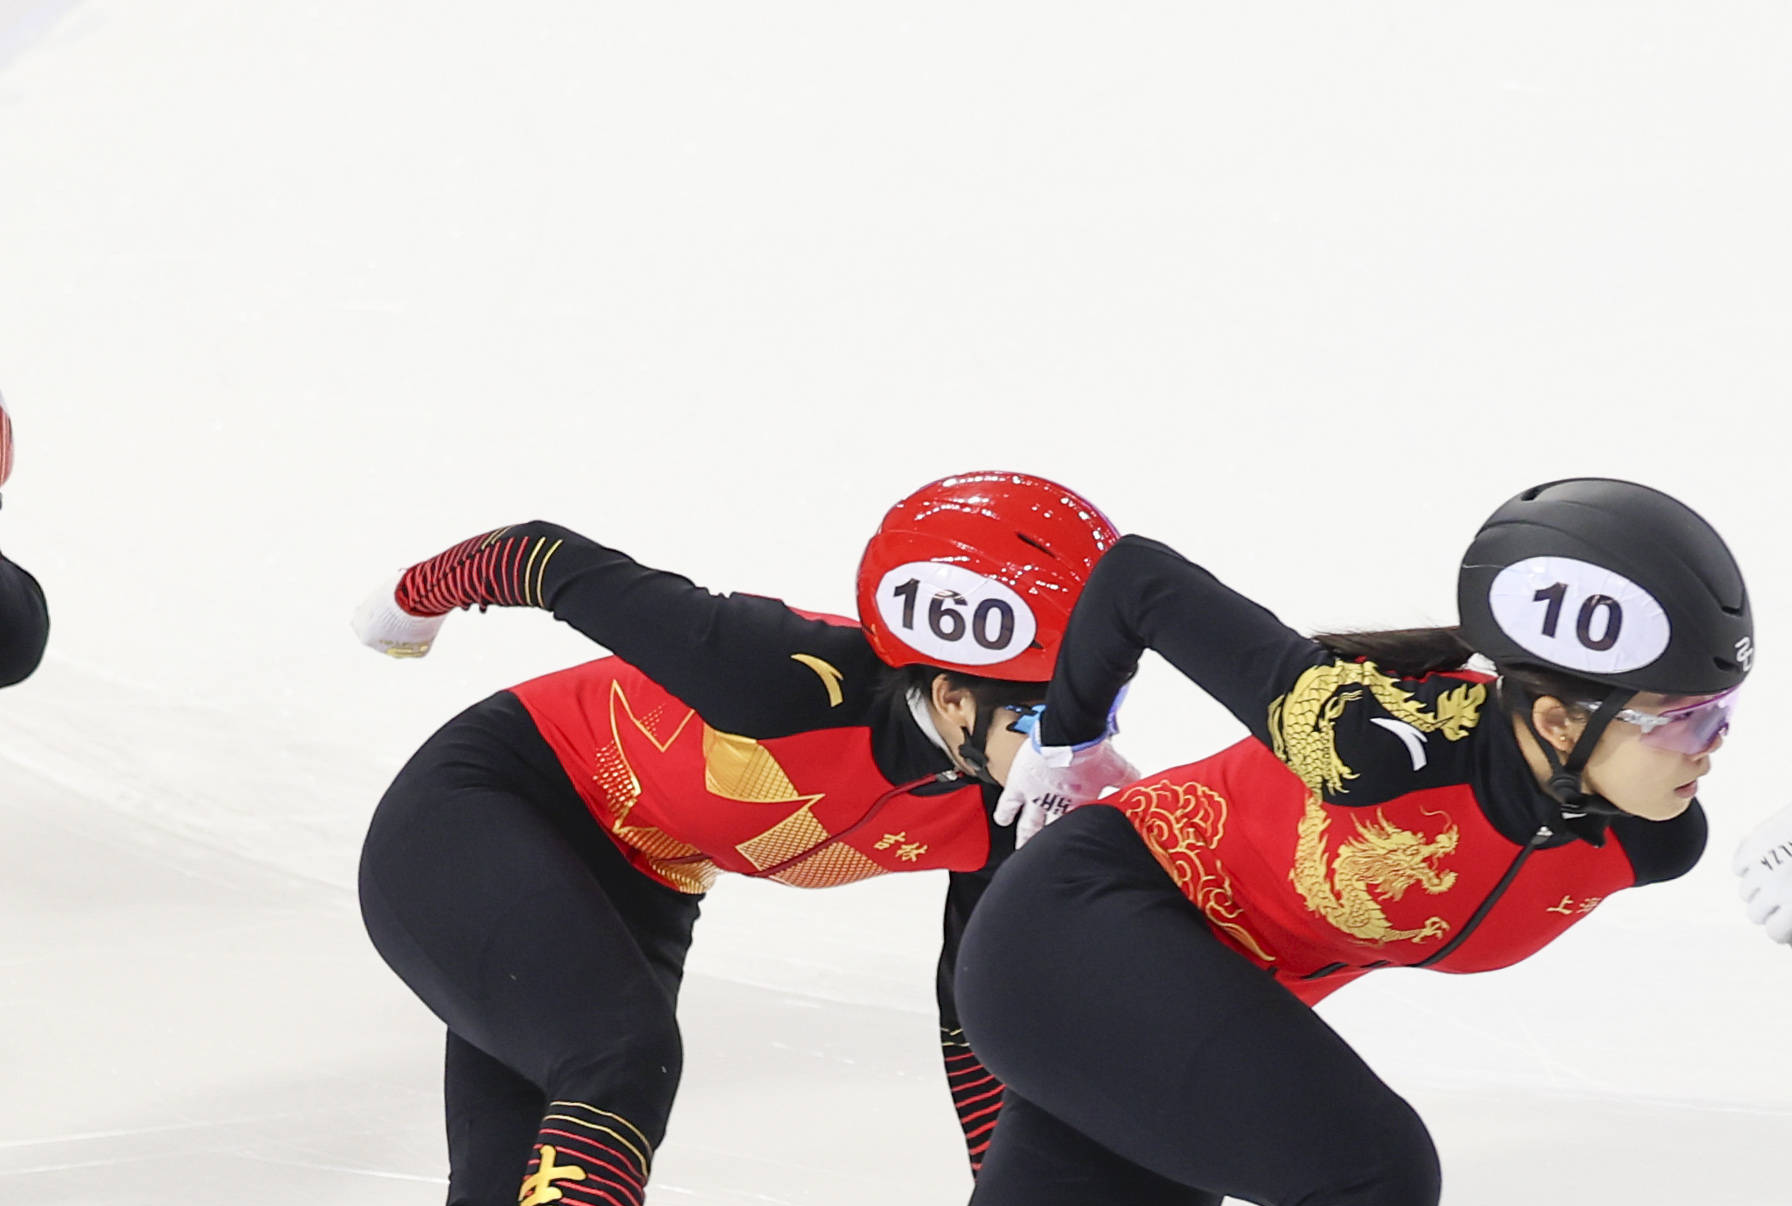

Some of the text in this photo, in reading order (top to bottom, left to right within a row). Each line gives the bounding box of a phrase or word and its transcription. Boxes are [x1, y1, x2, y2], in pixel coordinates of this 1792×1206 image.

[893, 578, 1015, 650] 160
[1532, 582, 1623, 652] 10
[874, 831, 928, 862] 吉林
